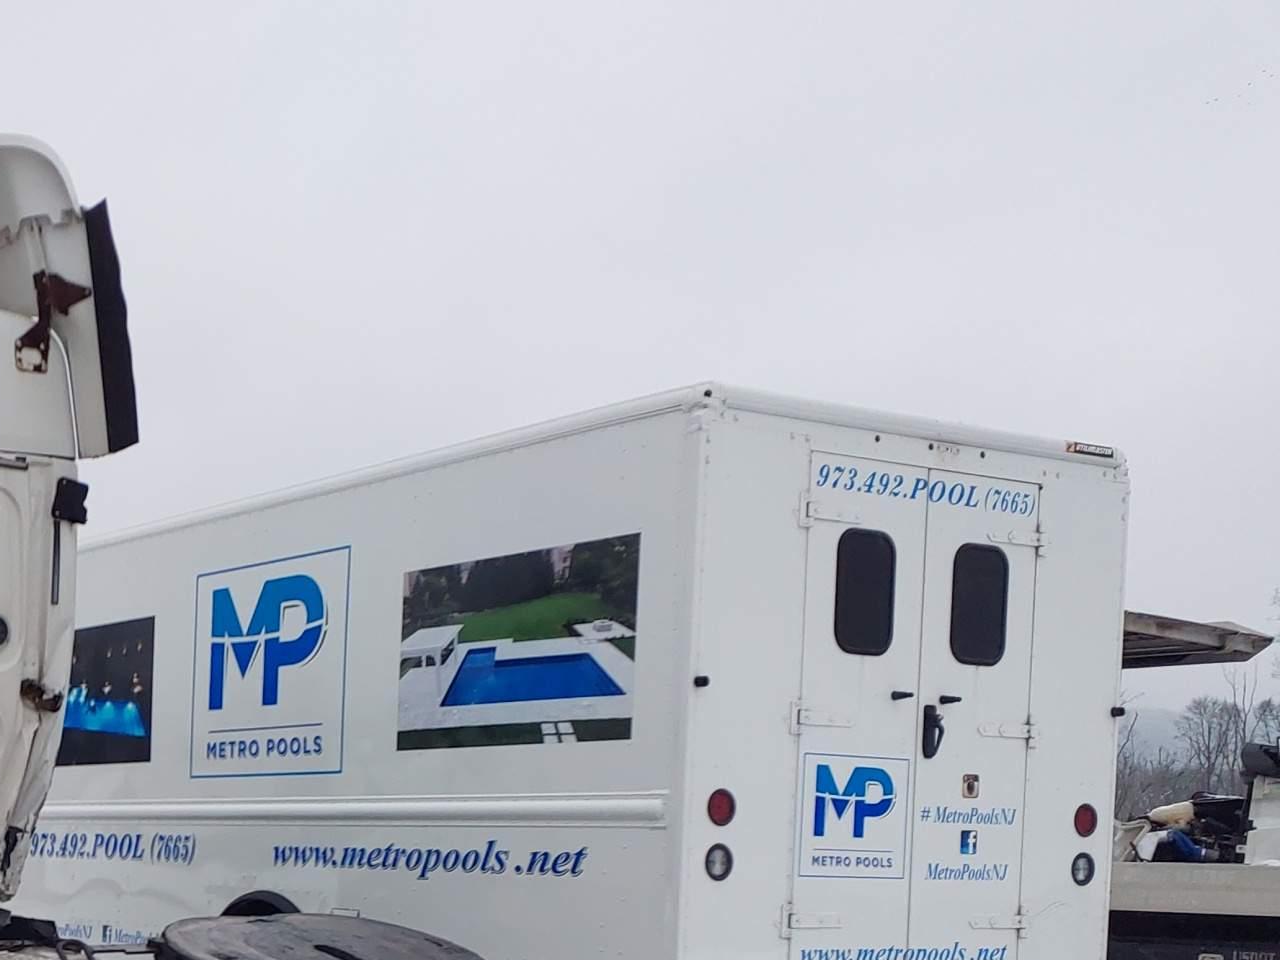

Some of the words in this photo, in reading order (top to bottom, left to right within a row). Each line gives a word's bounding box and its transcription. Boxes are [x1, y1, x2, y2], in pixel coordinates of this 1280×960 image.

[816, 464, 979, 508] 973.492.POOL
[984, 487, 1035, 518] (7665)
[208, 574, 328, 711] MP
[206, 739, 259, 760] METRO
[266, 735, 322, 757] POOLS
[813, 764, 896, 838] MP
[933, 806, 1017, 825] MetroPoolsNJ
[30, 832, 145, 861] 973.492.POOL
[150, 832, 196, 866] (7665)
[812, 855, 851, 868] METRO
[855, 857, 893, 869] POOLS
[925, 862, 1009, 881] MetroPoolsNJ
